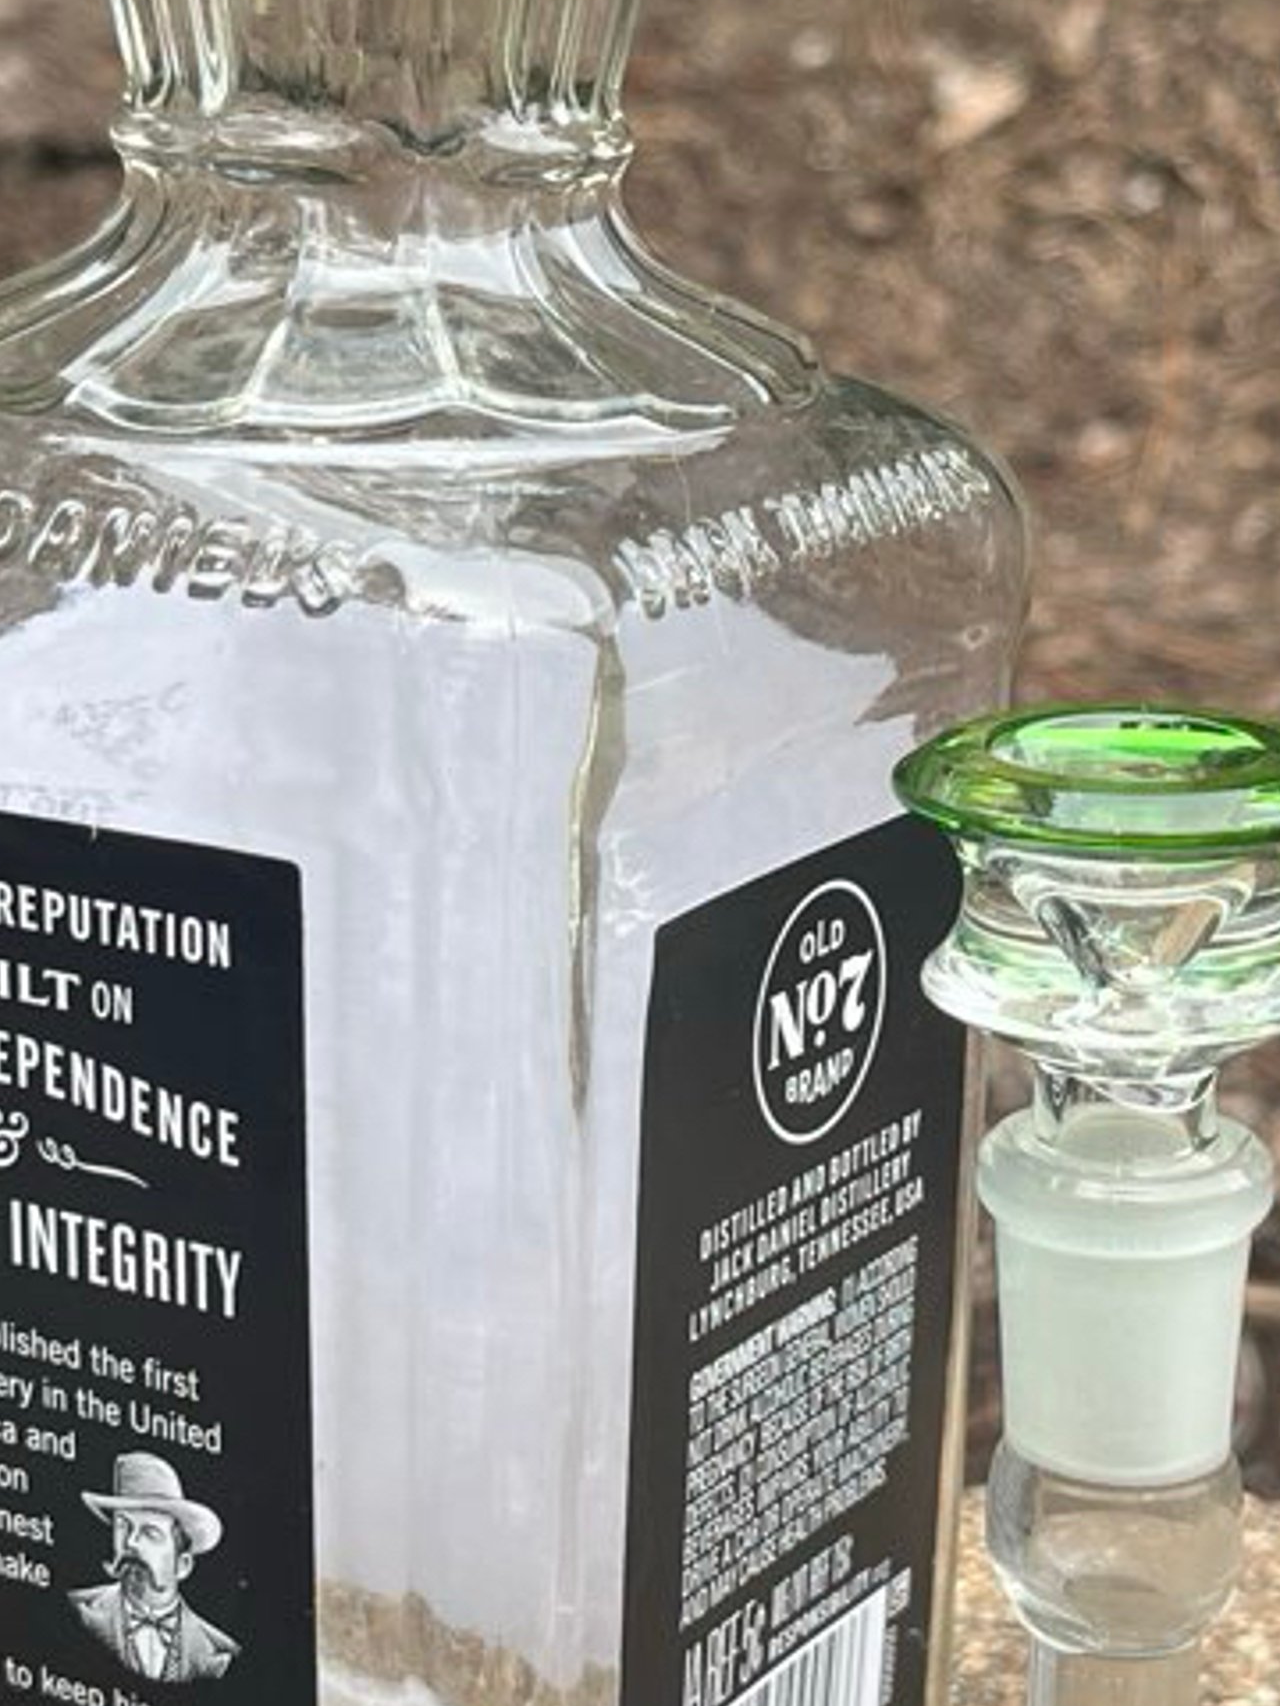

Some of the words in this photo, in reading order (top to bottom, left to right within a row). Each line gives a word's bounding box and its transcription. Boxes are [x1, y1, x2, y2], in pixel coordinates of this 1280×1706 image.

[800, 918, 845, 964] OLD
[92, 981, 133, 1025] ON
[785, 1048, 854, 1104] BRAND
[700, 1184, 787, 1261] DISTILLED
[791, 1164, 826, 1206] AND
[830, 1125, 899, 1184] BOTTLED
[902, 1108, 922, 1144] BY
[895, 1177, 923, 1222] USA
[710, 1250, 754, 1293] JACK
[757, 1210, 816, 1265] DANIEL
[821, 1150, 911, 1229] DISTILLERY
[9, 1200, 243, 1320] INTEGRITY
[89, 1345, 135, 1387] the
[143, 1357, 200, 1401] first
[25, 1423, 76, 1461] and
[42, 1375, 68, 1411] in
[76, 1388, 121, 1427] the
[129, 1401, 222, 1453] United
[5, 1657, 32, 1688] to
